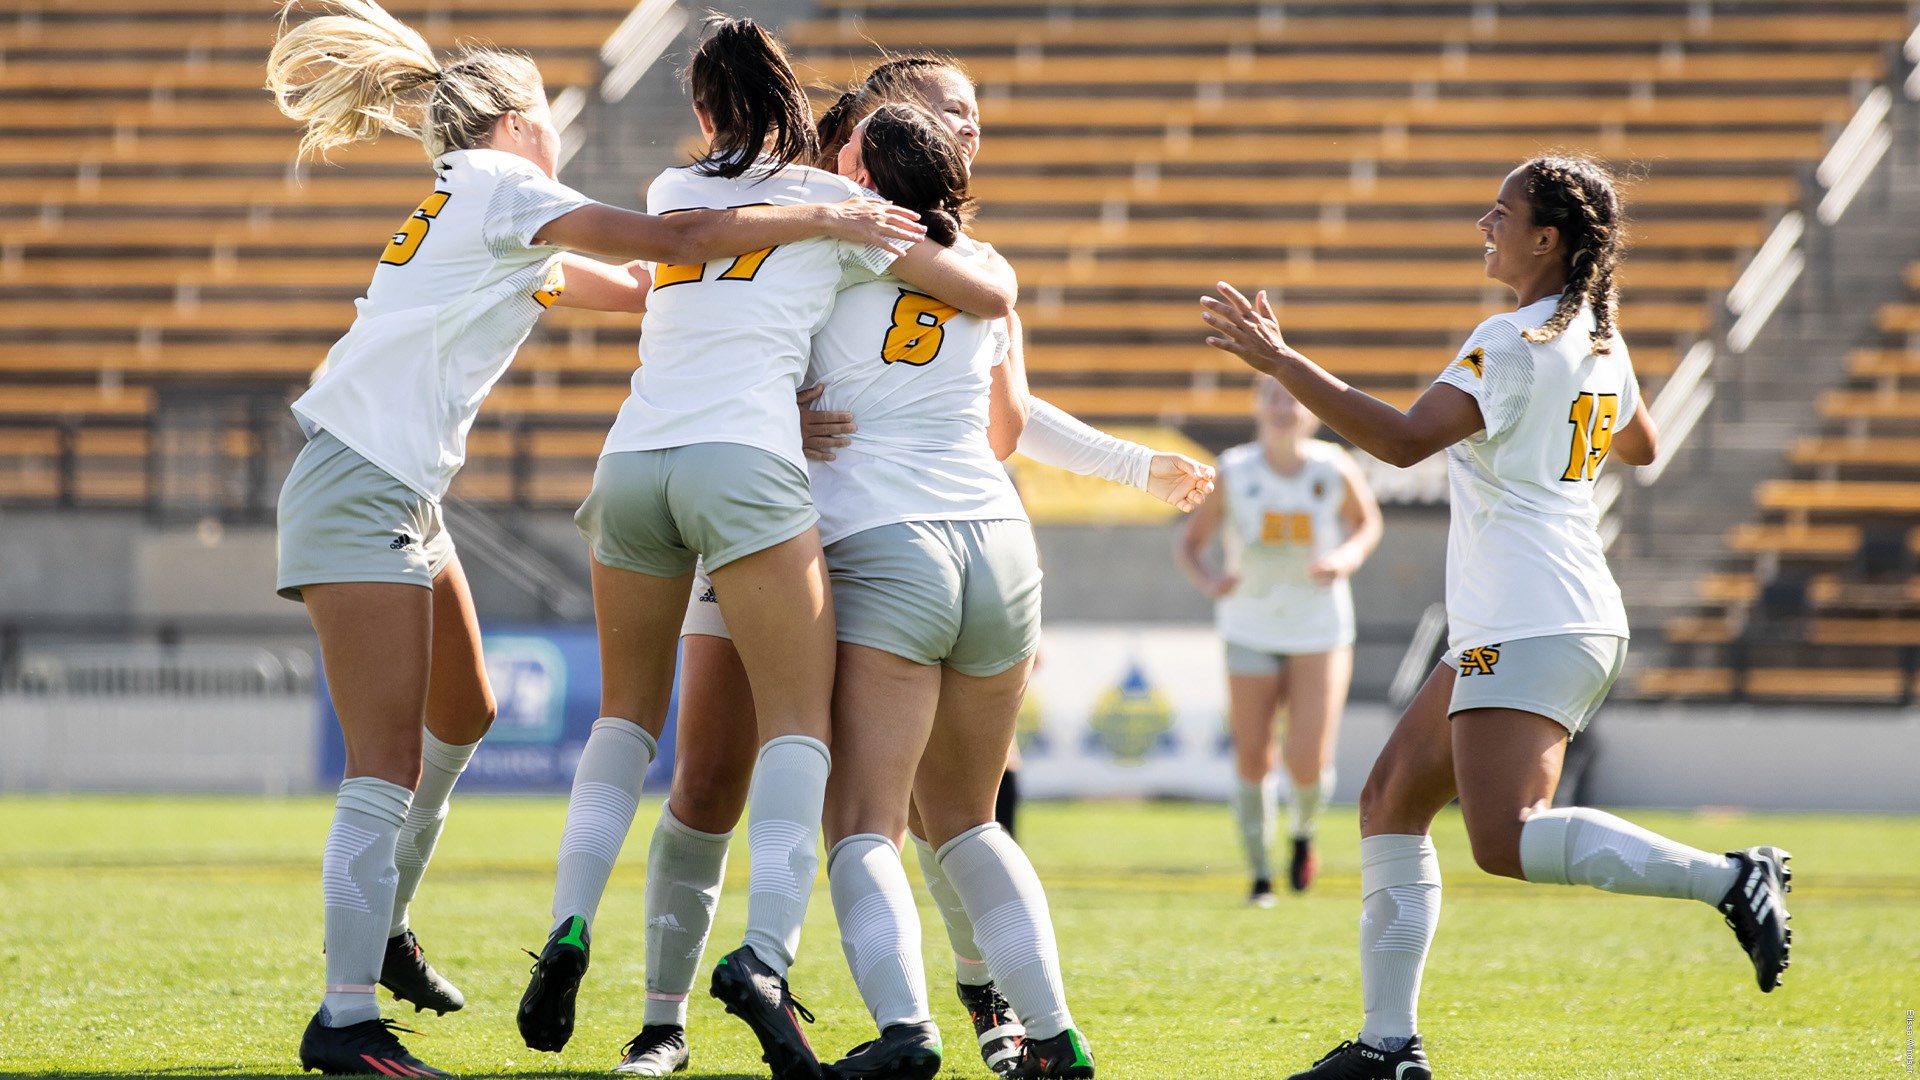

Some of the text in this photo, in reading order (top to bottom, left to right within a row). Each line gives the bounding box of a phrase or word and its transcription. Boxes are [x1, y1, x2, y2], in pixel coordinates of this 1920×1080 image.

[880, 286, 963, 367] 8
[1559, 391, 1618, 482] 19
[1361, 1050, 1385, 1062] COPA
